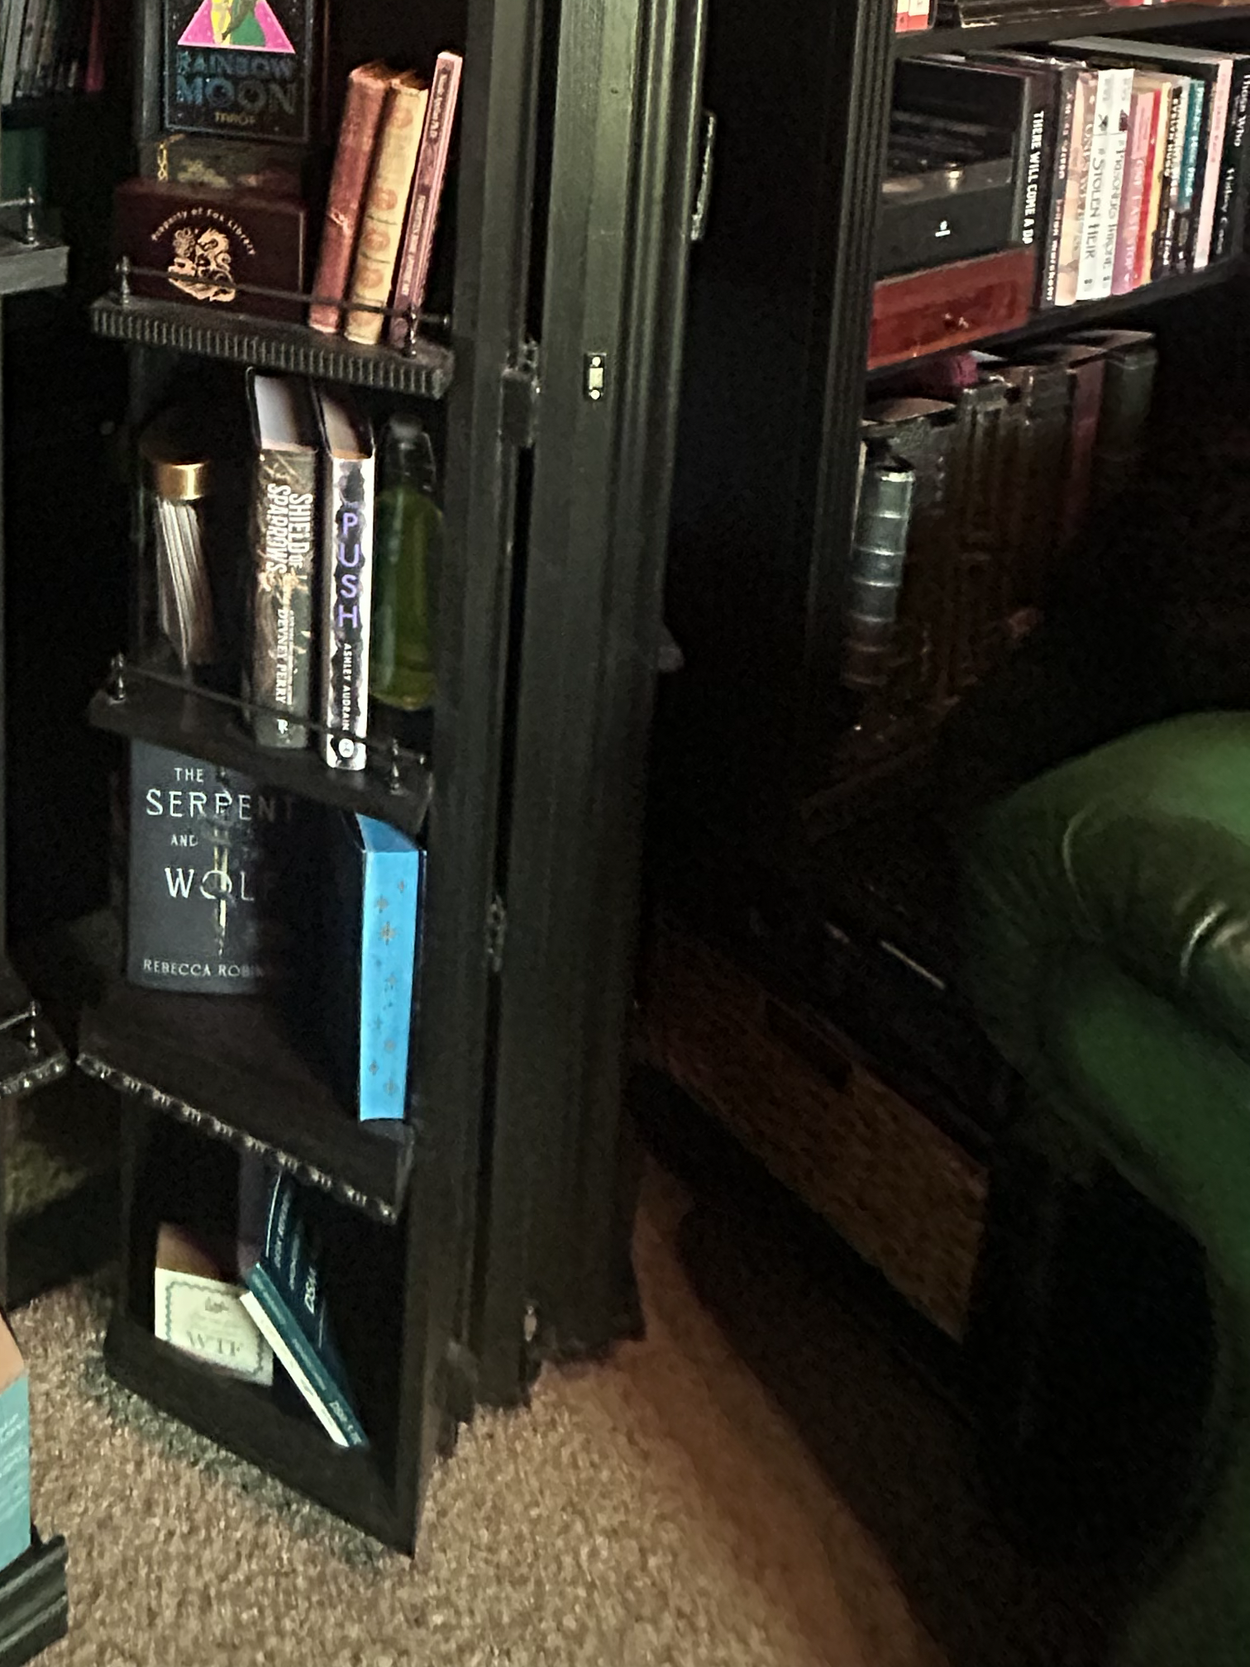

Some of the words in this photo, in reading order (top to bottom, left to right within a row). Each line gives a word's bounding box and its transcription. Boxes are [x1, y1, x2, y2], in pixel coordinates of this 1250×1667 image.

[177, 50, 296, 81] RAINBOW
[176, 76, 297, 116] MOON
[1030, 110, 1045, 150] THERE
[1027, 150, 1041, 183] WILL
[1024, 183, 1038, 216] COME
[1089, 157, 1106, 218] STOLEN
[151, 211, 188, 241] Property
[207, 209, 224, 222] Fox
[228, 220, 256, 255] Library
[1084, 223, 1101, 260] HEIR
[265, 483, 291, 573] SPARROWS
[288, 493, 314, 553] SHIELD
[337, 512, 362, 629] PUSH
[276, 609, 289, 662] DEVNEY
[342, 643, 353, 681] ASHLEY
[275, 663, 289, 705] PERRY
[340, 684, 352, 731] AUDRAIN
[174, 767, 204, 783] THE
[170, 834, 199, 847] AND
[164, 867, 262, 902] WOL
[143, 958, 212, 978] REBECCA
